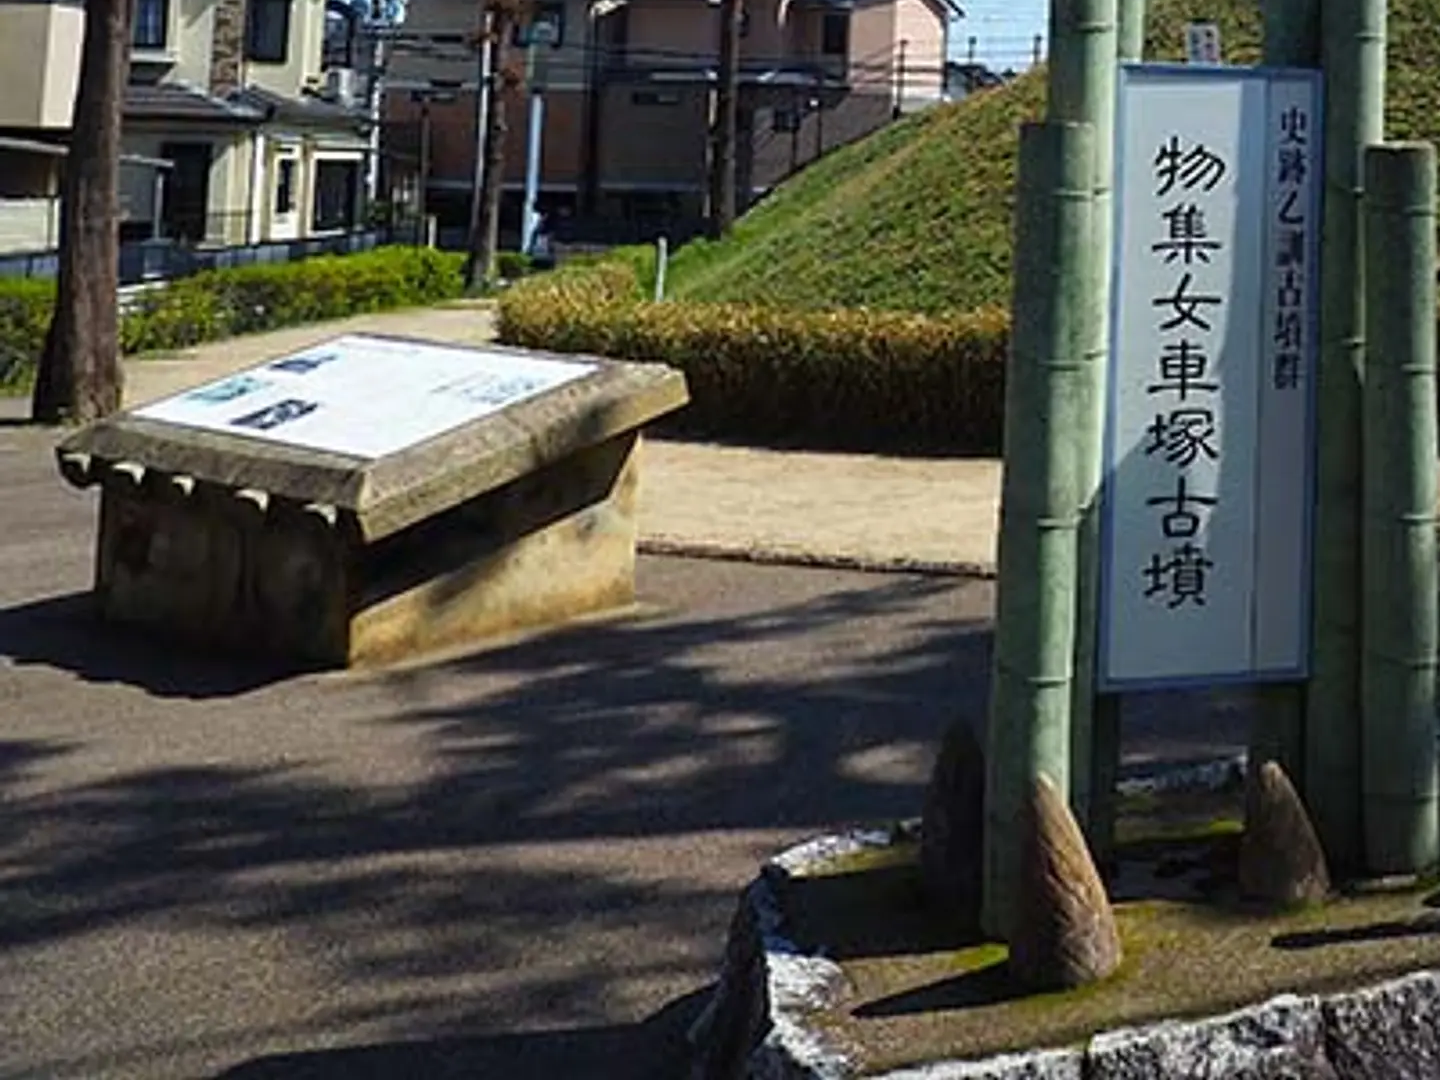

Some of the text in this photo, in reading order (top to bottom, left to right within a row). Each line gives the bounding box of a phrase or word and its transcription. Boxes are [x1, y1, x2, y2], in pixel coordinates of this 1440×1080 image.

[1143, 136, 1227, 608] 物集女車塚古墳
